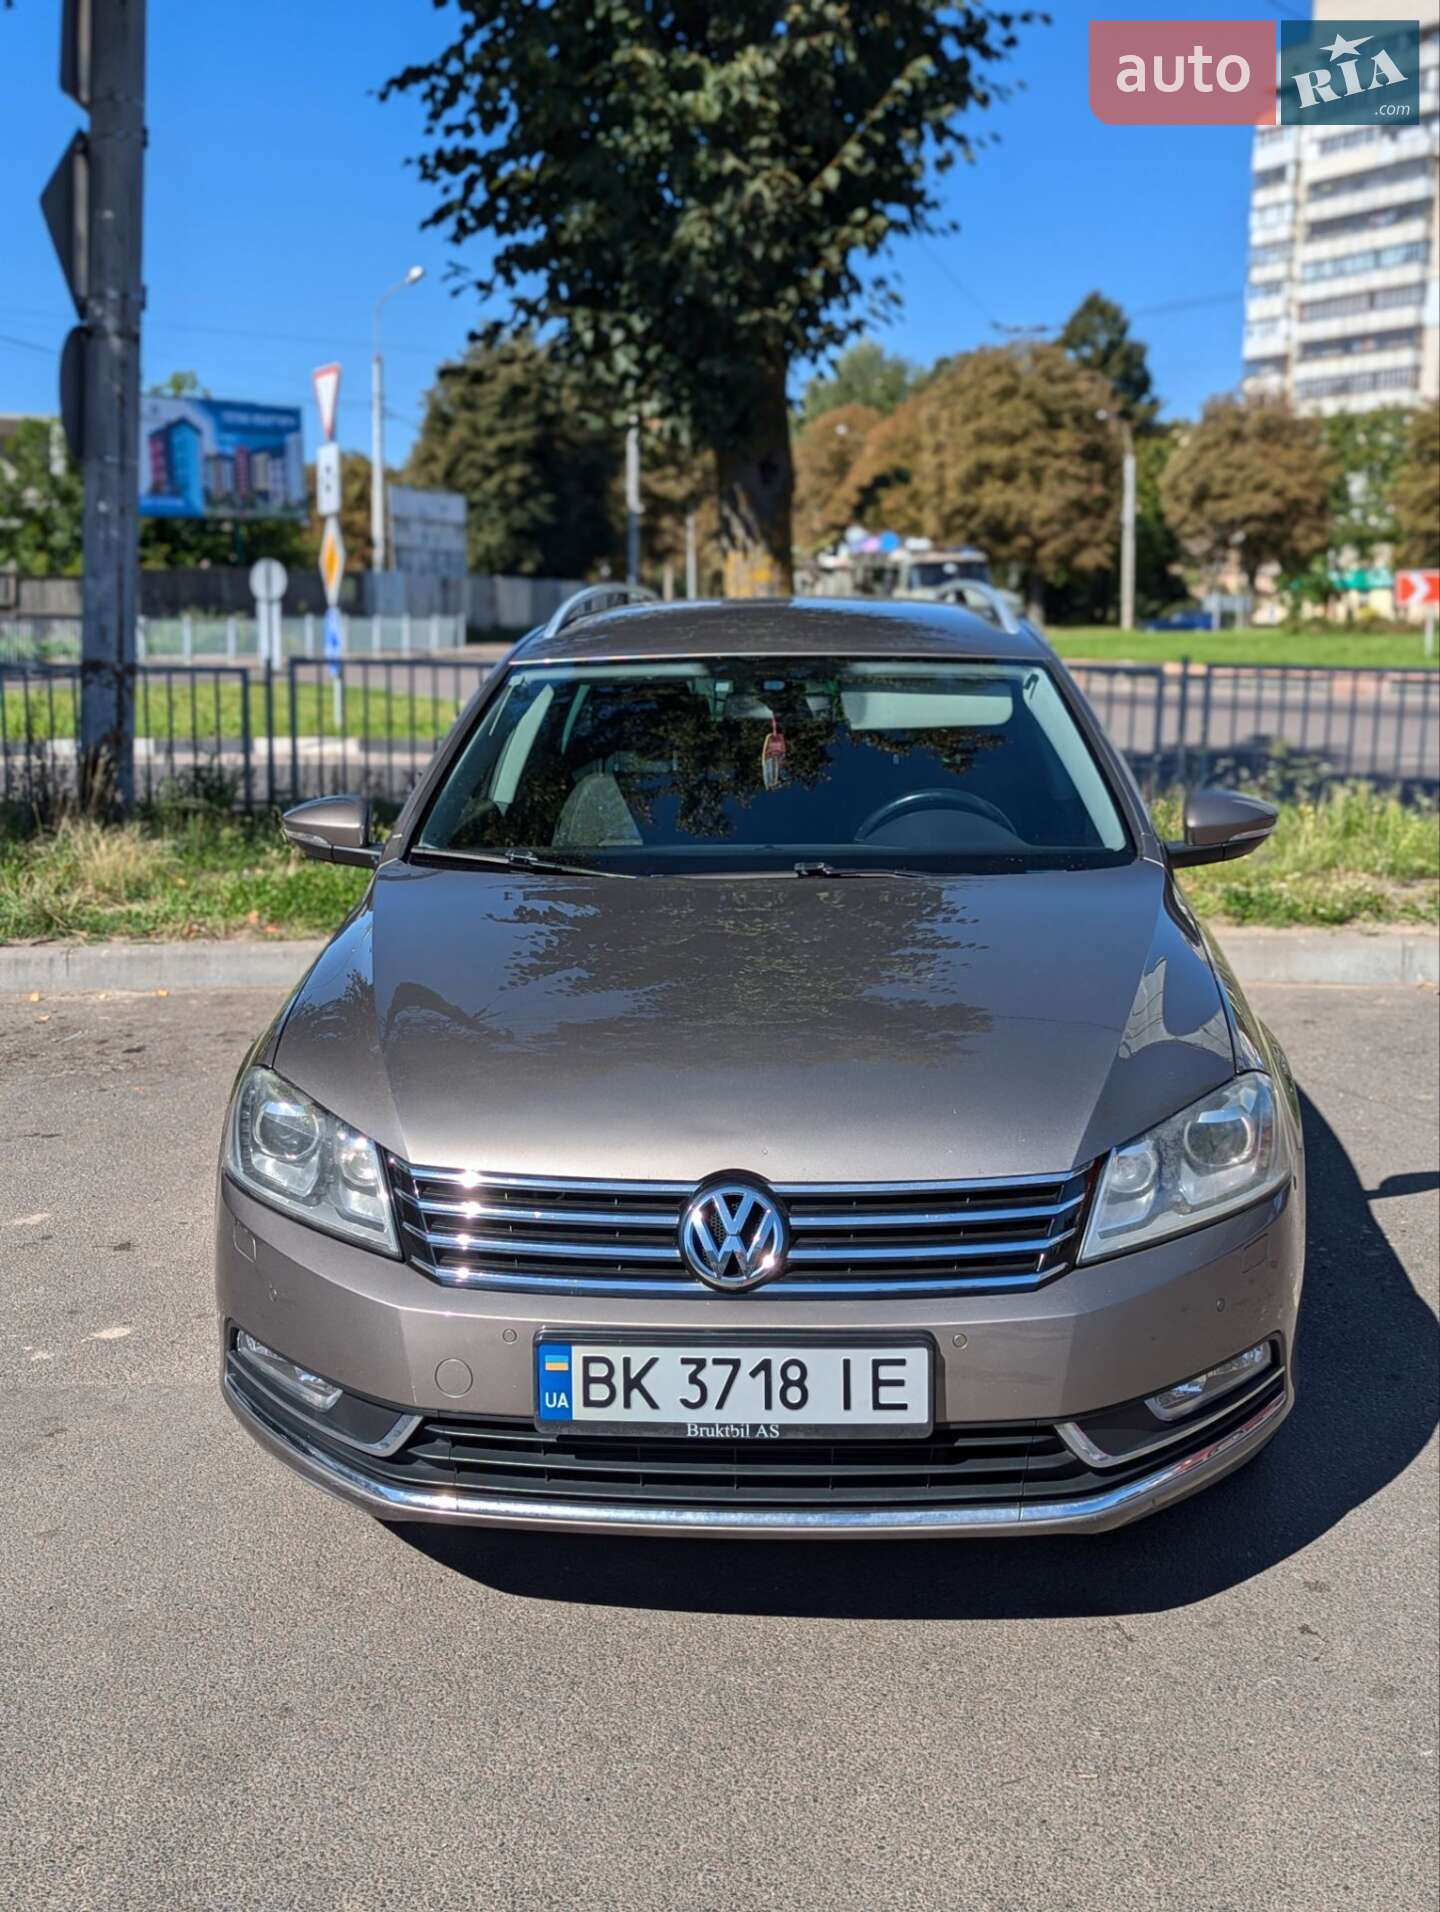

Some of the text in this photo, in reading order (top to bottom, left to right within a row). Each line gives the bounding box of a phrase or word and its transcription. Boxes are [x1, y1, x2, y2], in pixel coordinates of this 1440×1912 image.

[581, 1355, 908, 1411] BK 3718 IE
[545, 1392, 569, 1409] UA
[687, 1423, 780, 1438] Bruktbil AS
